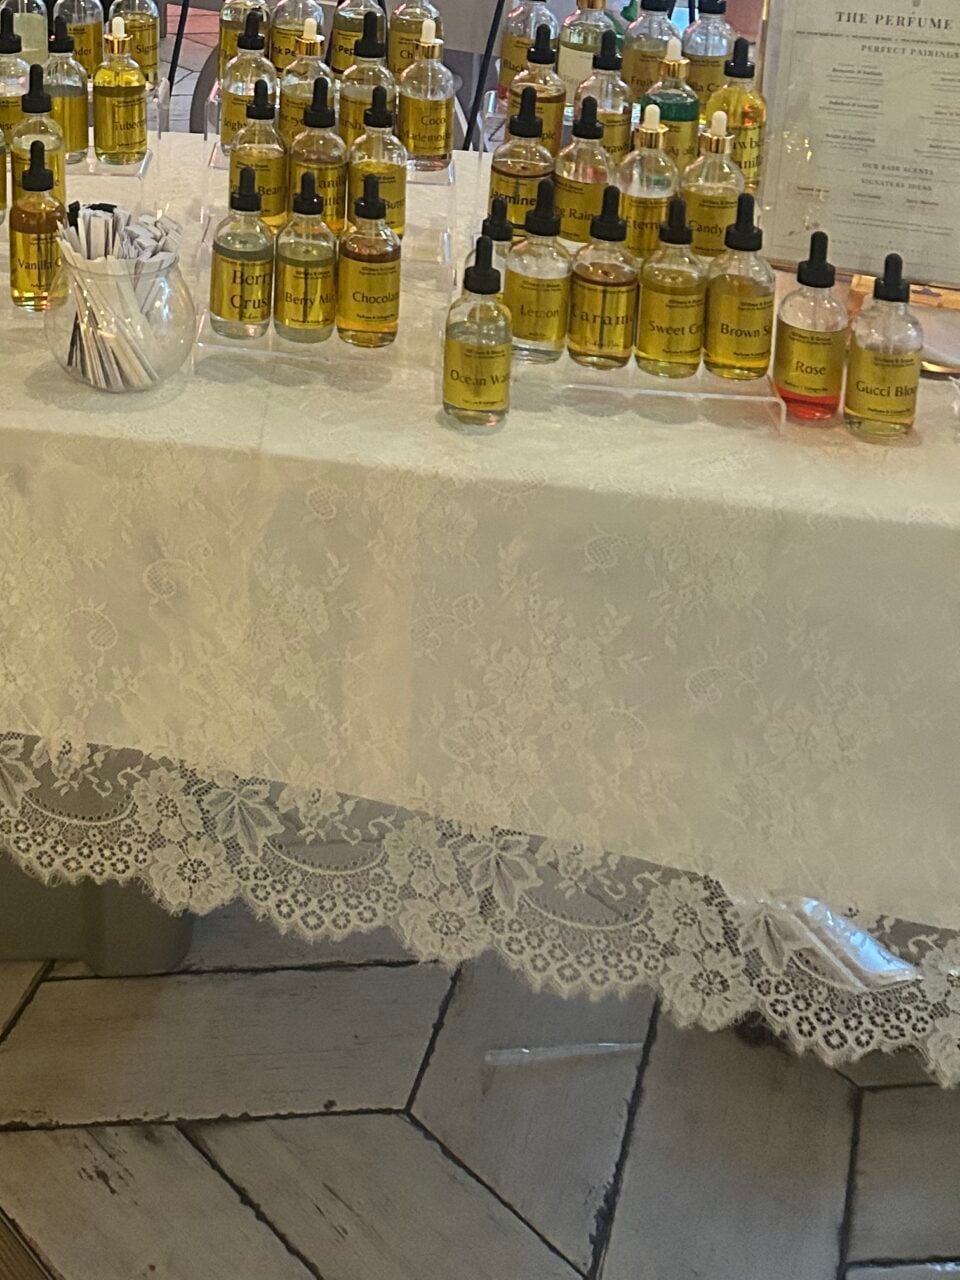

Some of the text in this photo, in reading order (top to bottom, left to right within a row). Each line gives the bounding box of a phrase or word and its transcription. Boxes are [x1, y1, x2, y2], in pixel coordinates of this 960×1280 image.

[835, 10, 953, 31] THE PERFUME
[860, 44, 907, 56] PERFECT
[519, 303, 560, 318] Lemon
[649, 320, 685, 336] Sweet
[719, 323, 761, 338] Brown
[794, 360, 827, 376] Rose
[449, 368, 487, 386] Ocean
[855, 380, 891, 398] Gucci
